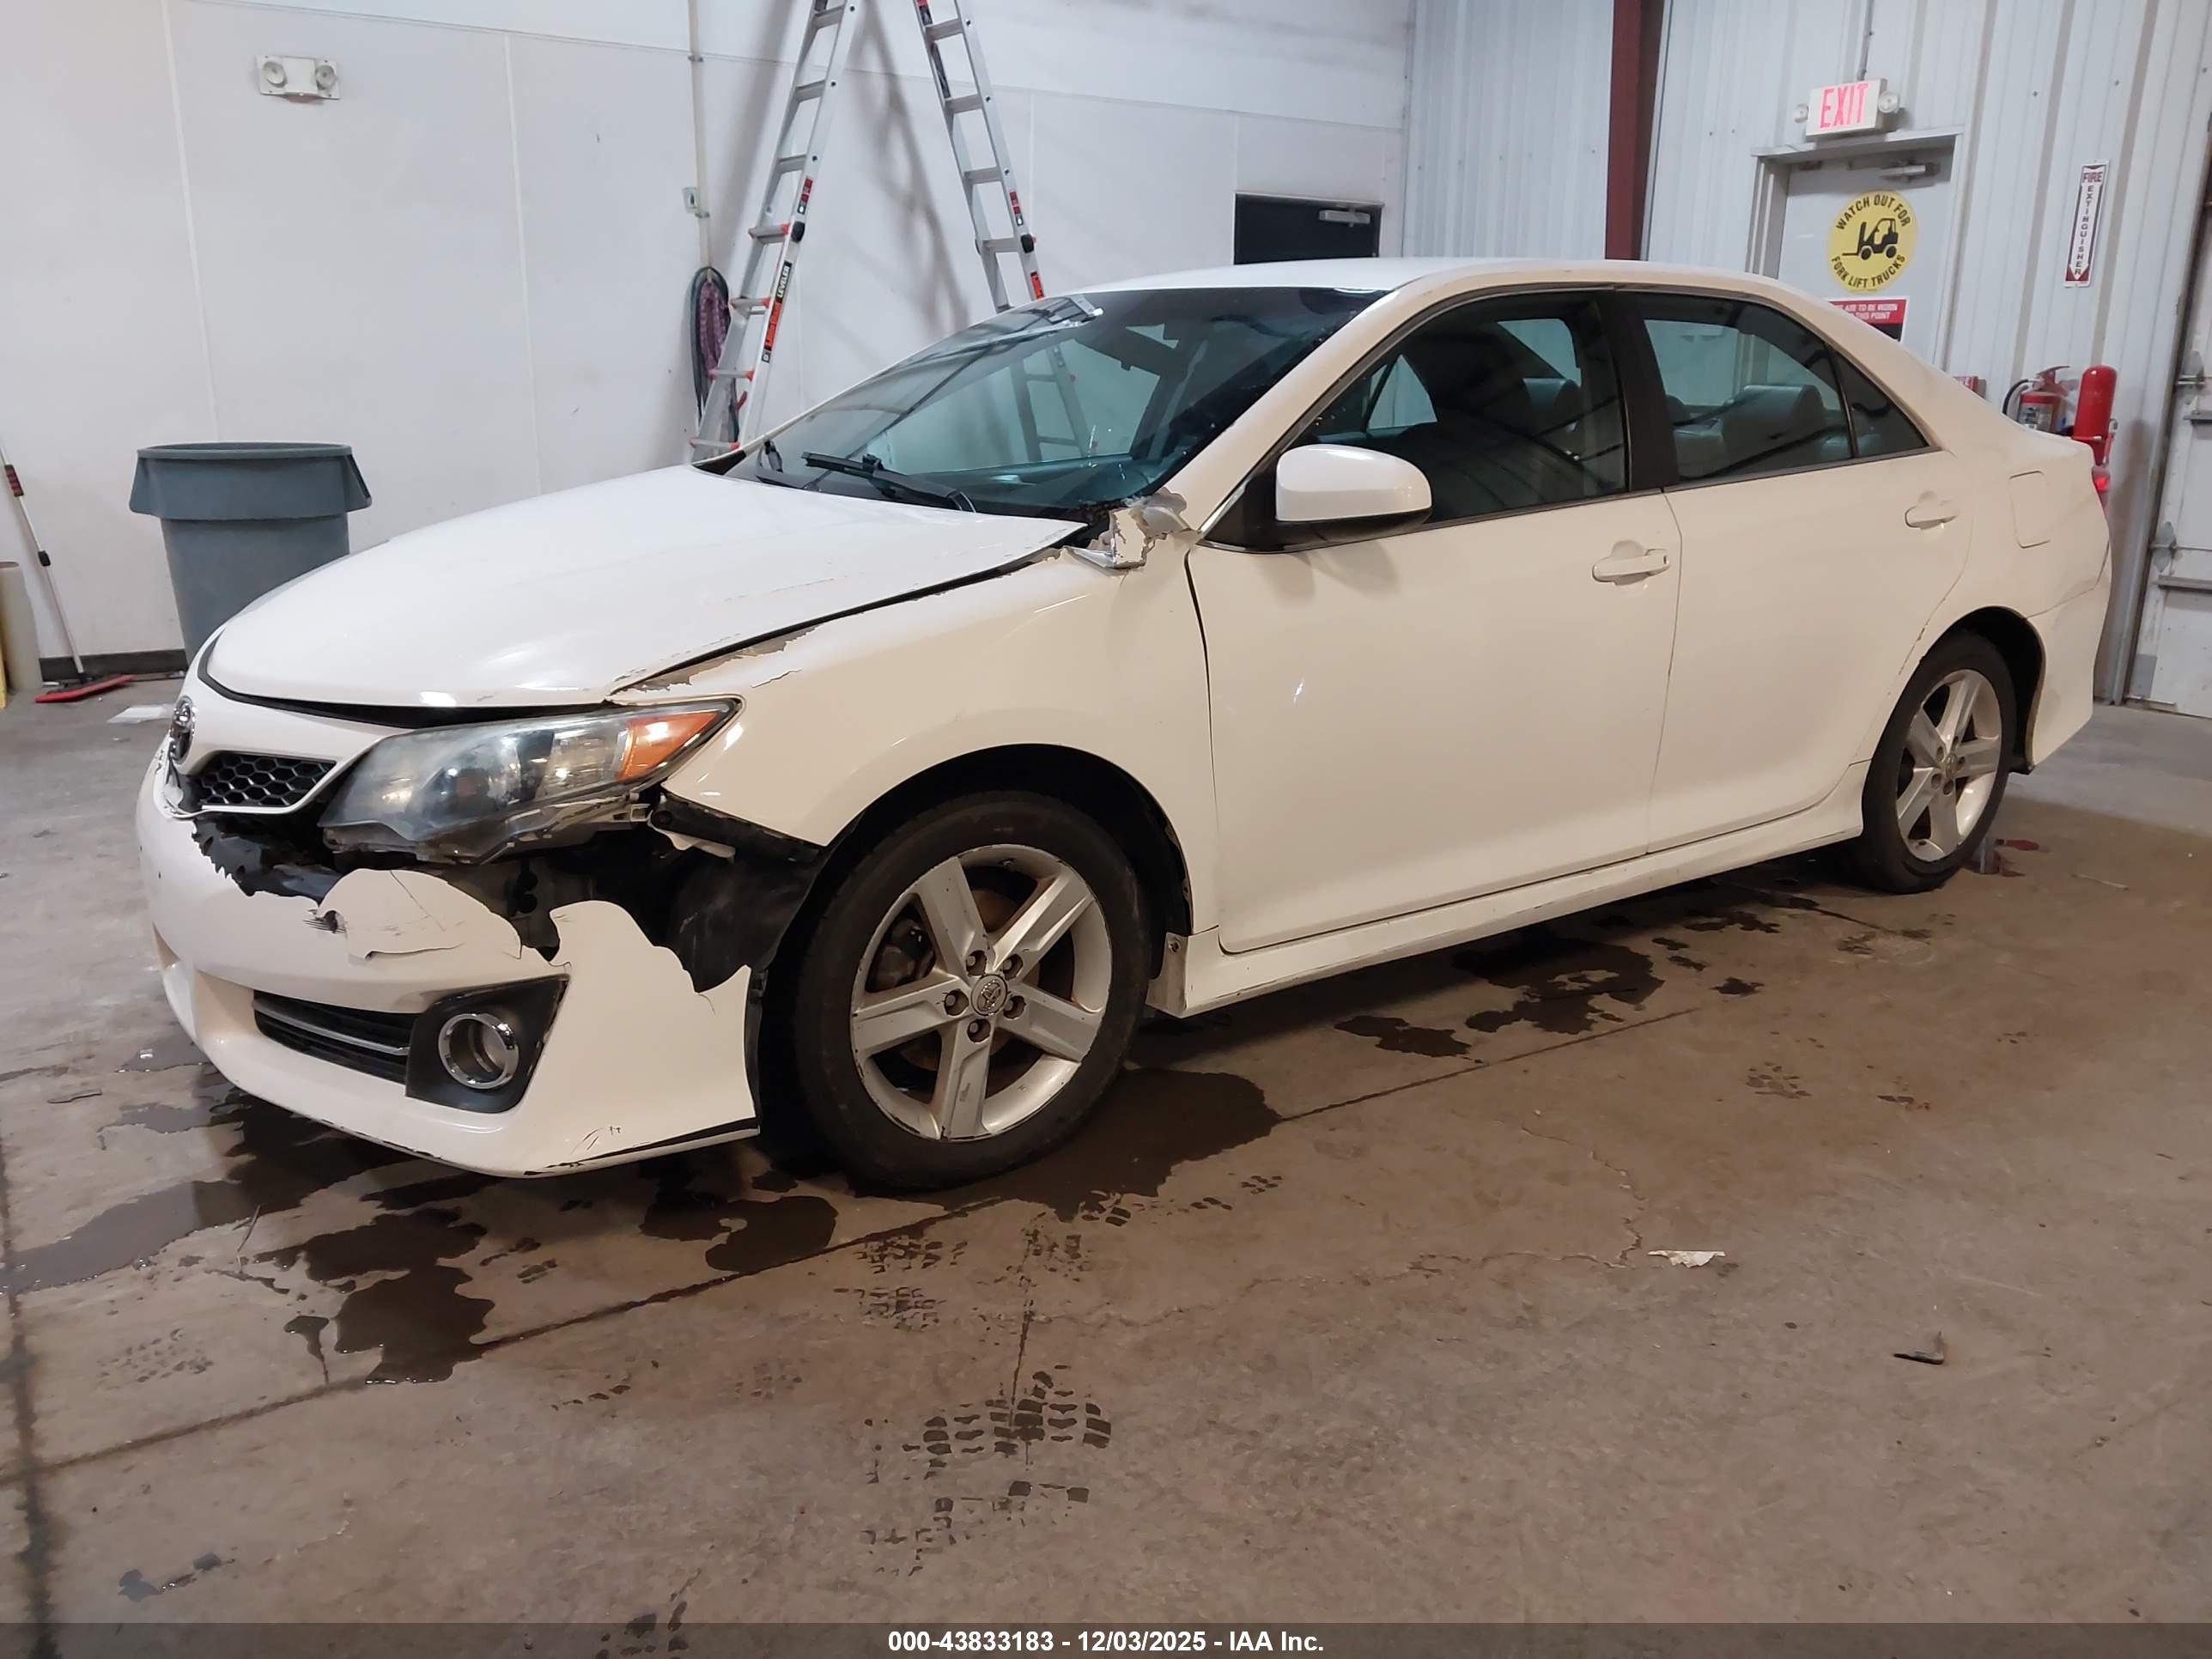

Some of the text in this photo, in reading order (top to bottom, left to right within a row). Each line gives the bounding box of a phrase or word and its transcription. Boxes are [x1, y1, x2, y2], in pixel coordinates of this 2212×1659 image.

[1819, 82, 1869, 129] EXIT
[2081, 172, 2103, 183] FIRE
[1836, 194, 1911, 230] WATCH OUT FOR
[2074, 185, 2094, 275] EXTINGUISHER
[777, 265, 791, 298] LEVELER
[1832, 254, 1905, 289] FORK LIFT TRUCKS
[1871, 312, 1891, 320] POINT
